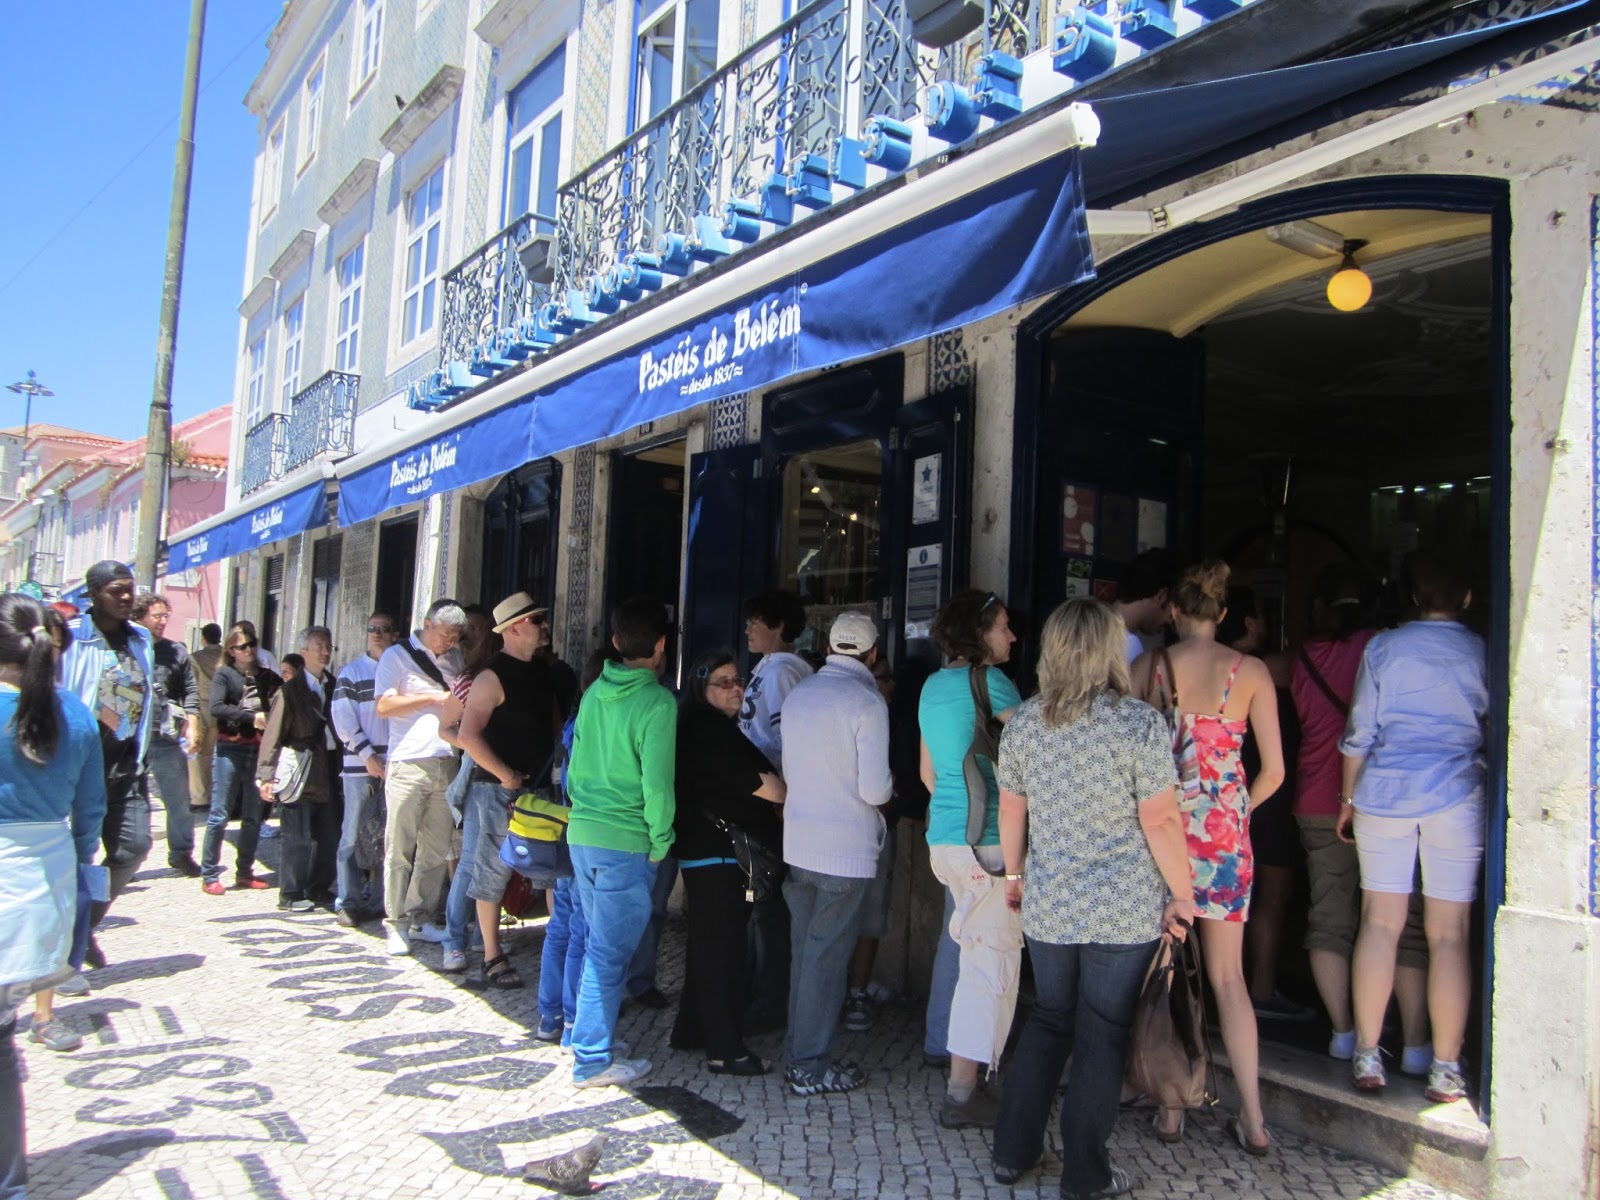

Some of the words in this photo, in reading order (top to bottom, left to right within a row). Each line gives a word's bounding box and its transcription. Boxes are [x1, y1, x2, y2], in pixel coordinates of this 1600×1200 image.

[639, 334, 700, 394] Pastéis
[703, 325, 728, 369] de
[732, 299, 802, 360] Belém
[712, 362, 736, 387] 1837
